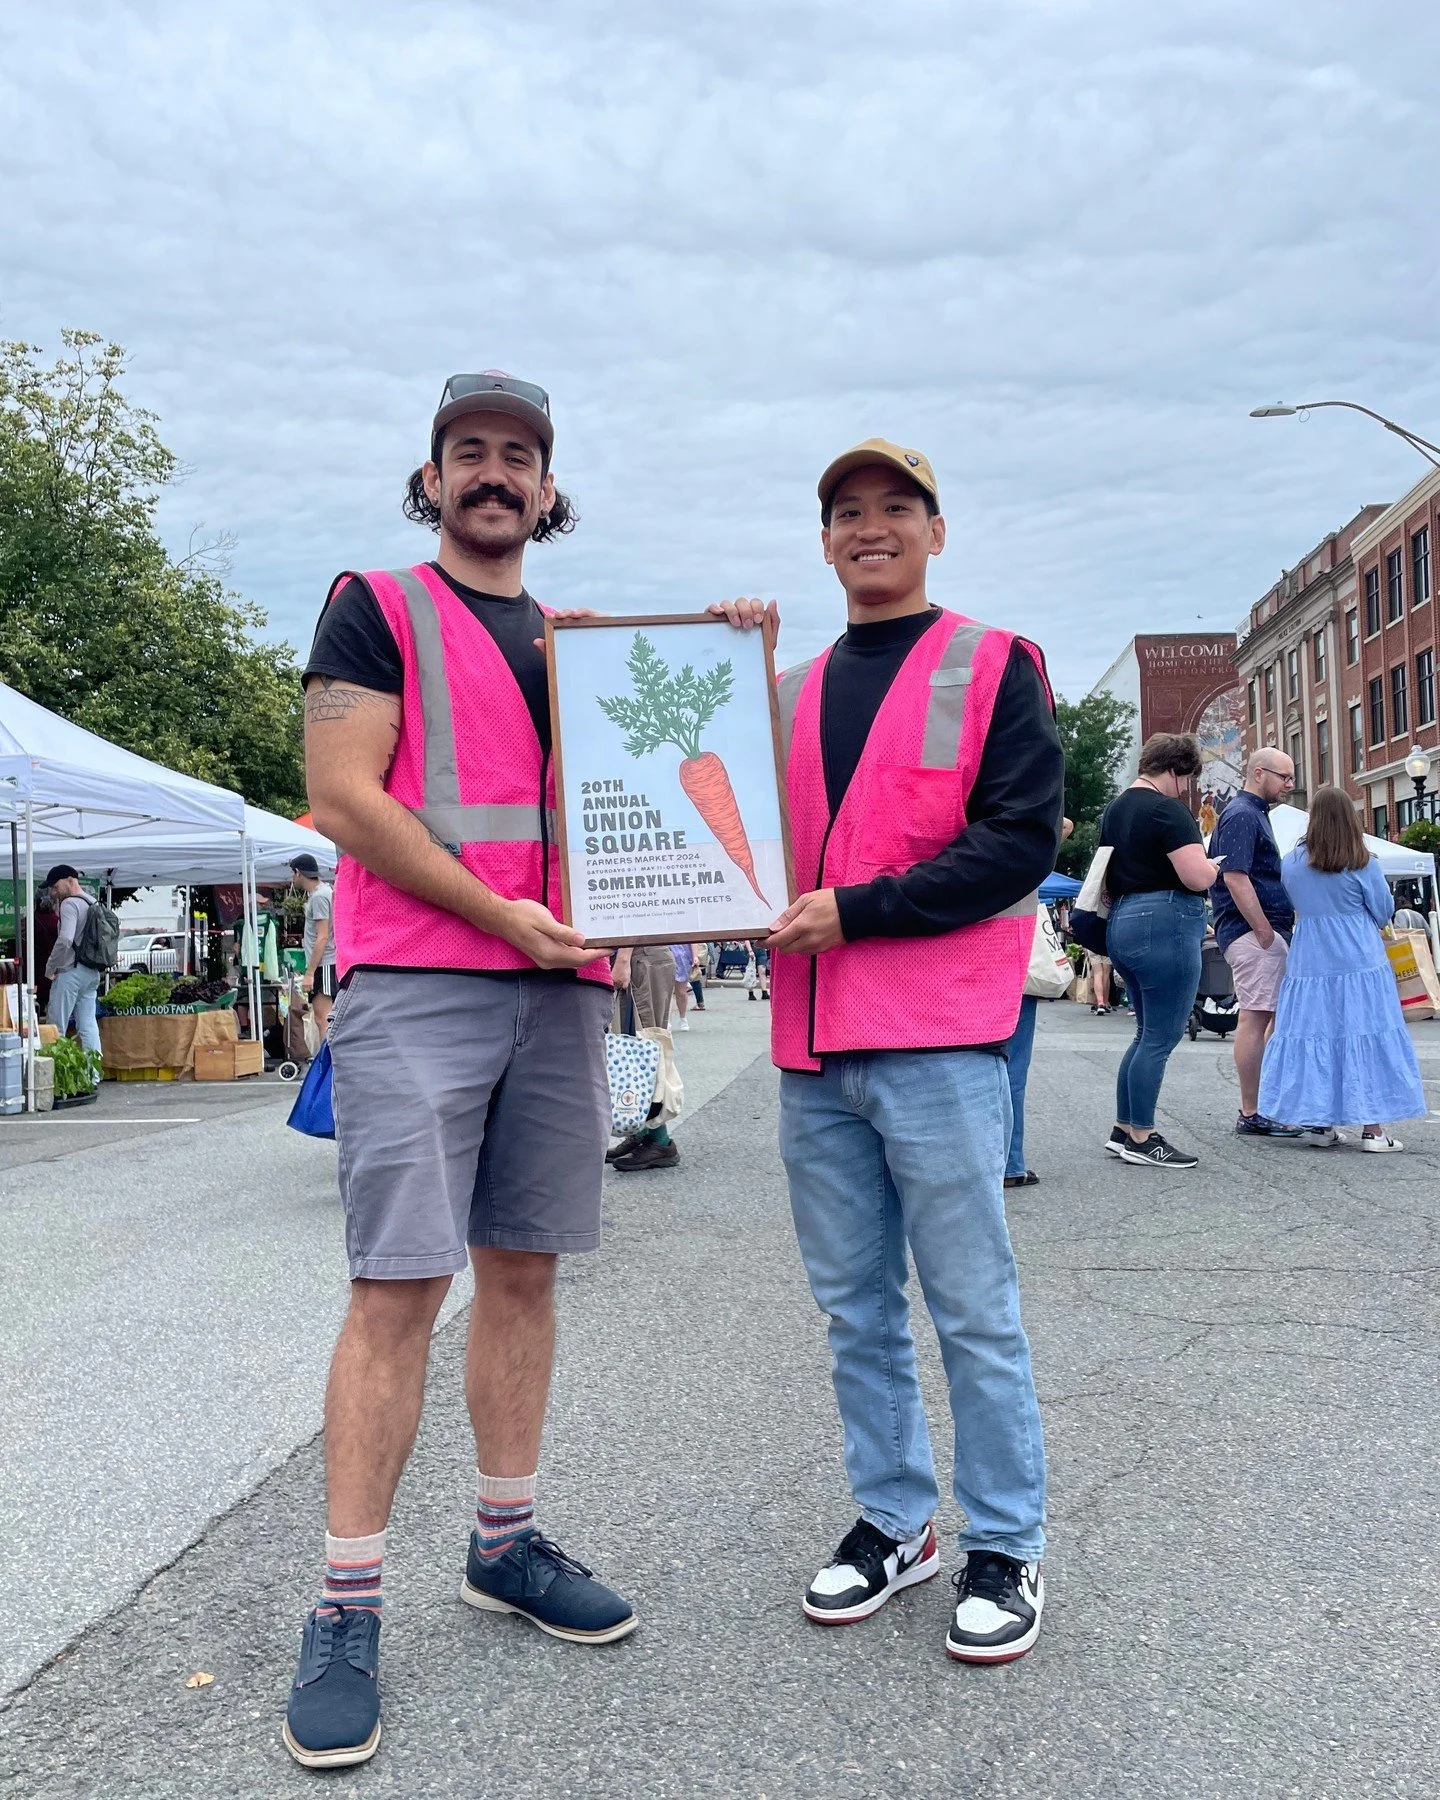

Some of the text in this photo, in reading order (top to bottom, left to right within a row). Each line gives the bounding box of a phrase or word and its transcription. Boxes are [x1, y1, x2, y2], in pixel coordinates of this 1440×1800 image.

[1145, 643, 1229, 659] WELCOME
[1211, 666, 1235, 674] PRO
[581, 779, 624, 794] 20TH
[582, 794, 650, 810] ANNUAL
[583, 810, 662, 832] UNION
[585, 831, 687, 855] SQUARE
[586, 853, 700, 866] FARMERS MARKET 2024
[587, 867, 625, 875] SATURDAYS
[589, 895, 732, 911] UNION SQUARE MAIN STREETS
[1395, 966, 1418, 978] HEESE
[116, 1004, 194, 1016] GOOD FOOD FARM
